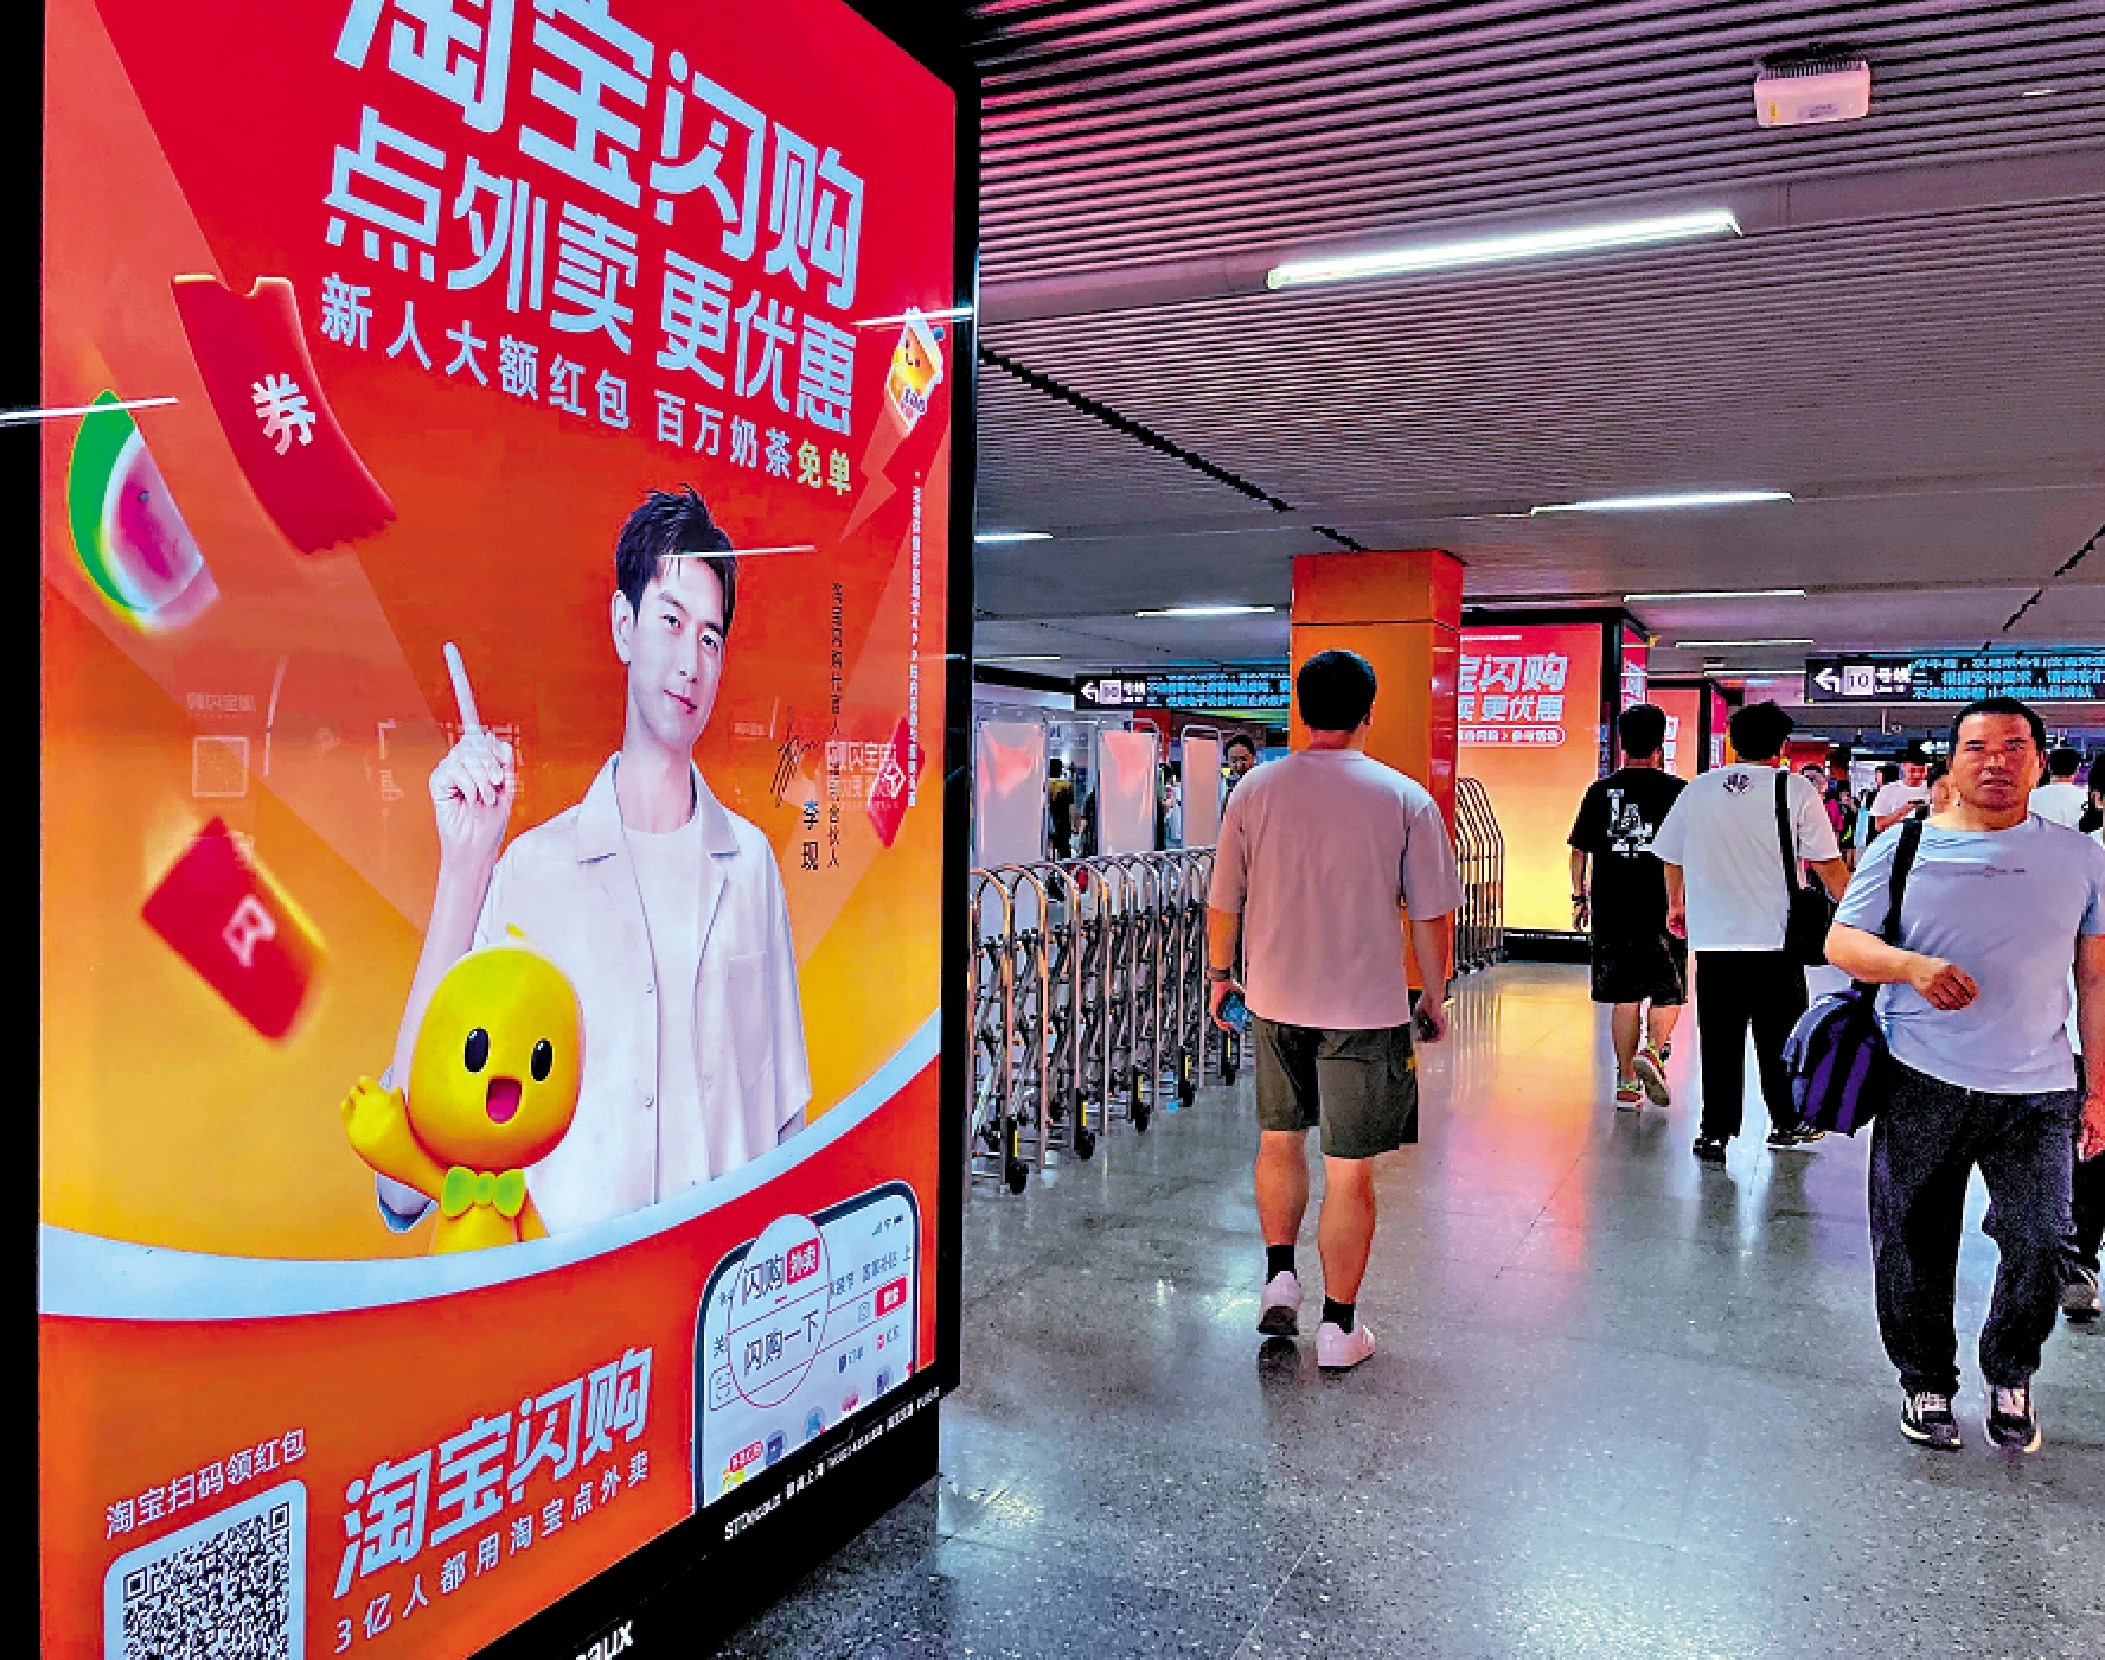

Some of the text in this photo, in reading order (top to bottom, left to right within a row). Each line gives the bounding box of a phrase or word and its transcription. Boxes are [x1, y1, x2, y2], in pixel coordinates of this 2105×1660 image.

[323, 104, 859, 437] 点外卖 更优惠
[251, 372, 316, 456] 券
[320, 272, 853, 496] 新人大额红包 百万奶茶免单
[105, 1428, 307, 1541] 淘宝扫码领红包
[332, 1345, 653, 1600] 淘宝闪购
[333, 1450, 650, 1654] 3亿人都用淘宝点外卖
